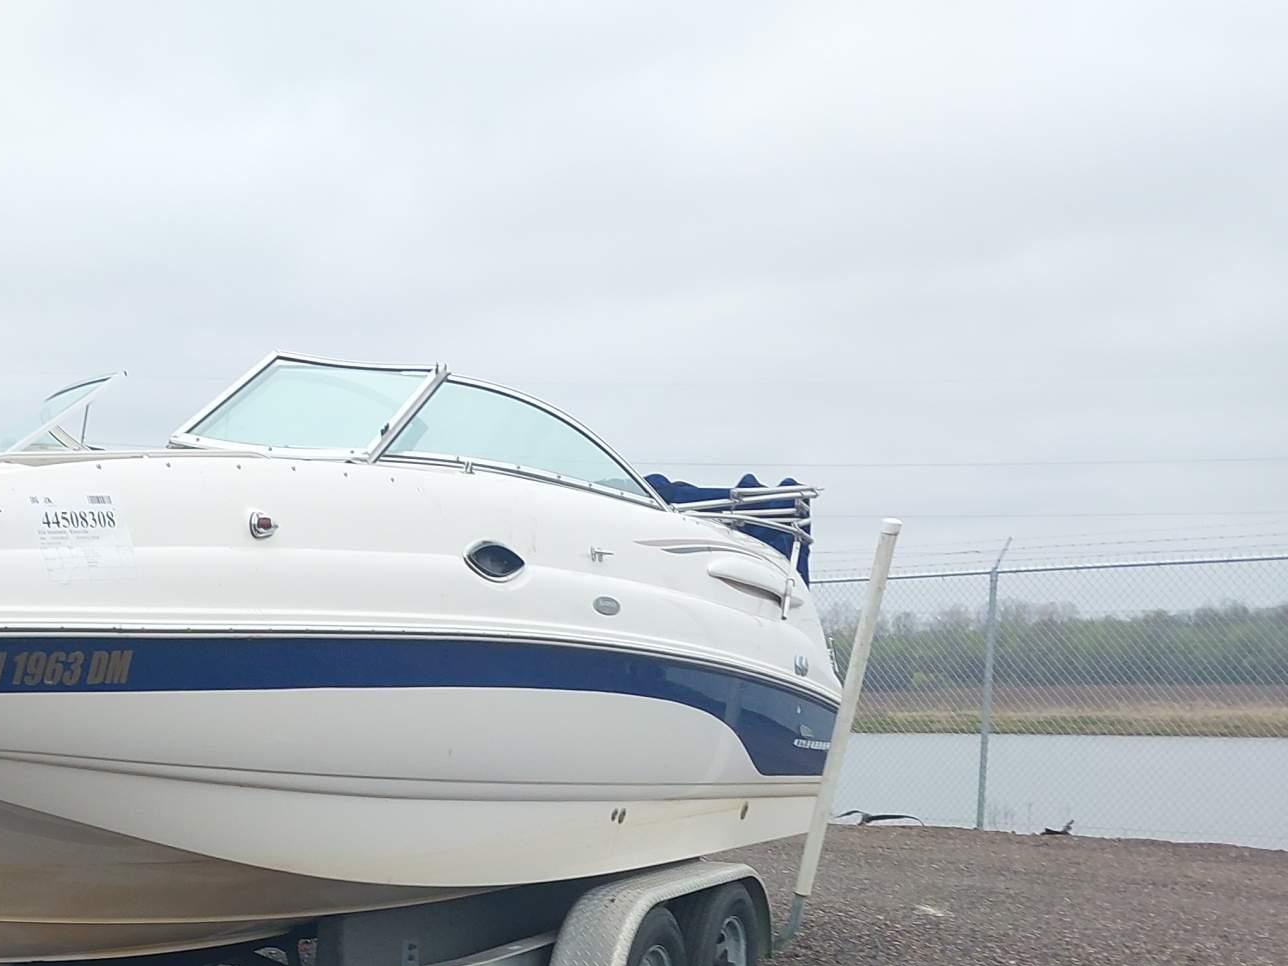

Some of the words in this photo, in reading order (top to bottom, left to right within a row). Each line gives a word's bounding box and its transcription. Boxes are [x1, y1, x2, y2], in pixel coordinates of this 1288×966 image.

[42, 511, 116, 528] 44508308
[12, 651, 85, 686] 1963
[87, 650, 133, 684] DM
